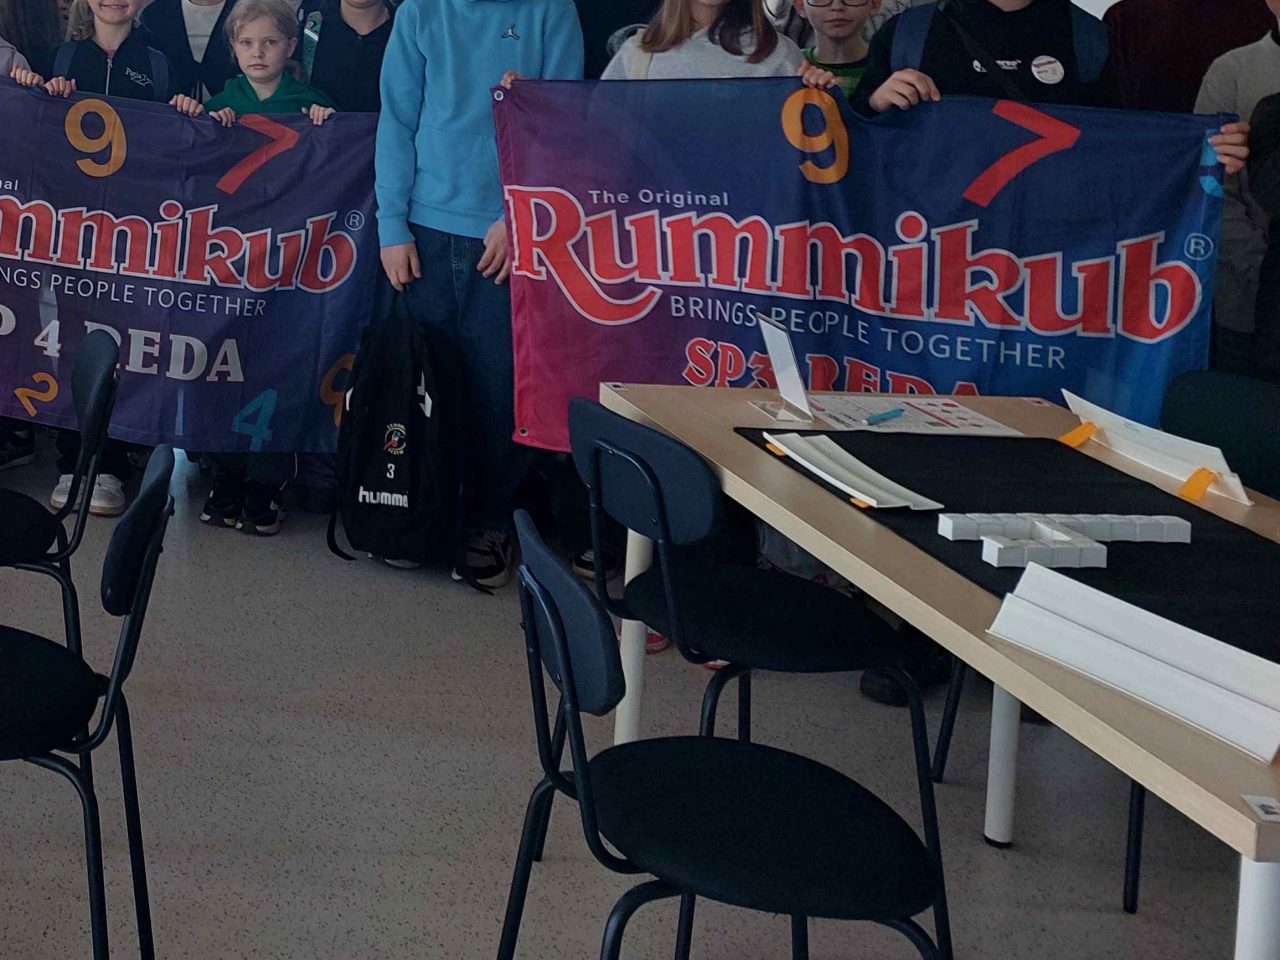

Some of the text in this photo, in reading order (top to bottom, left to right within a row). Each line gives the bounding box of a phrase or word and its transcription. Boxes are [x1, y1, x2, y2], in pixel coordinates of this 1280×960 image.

[65, 98, 127, 178] 9
[216, 113, 301, 195] 7
[781, 86, 850, 184] 9
[963, 99, 1082, 208] 7
[588, 190, 729, 208] The Original
[50, 273, 134, 304] PEOPLE
[144, 286, 267, 316] TOGETHER
[33, 320, 62, 358] 4
[671, 296, 1066, 370] BRINGS PEOPLE TOGETHER
[14, 372, 59, 417] 2
[232, 388, 278, 451] 4
[386, 463, 396, 479] 3
